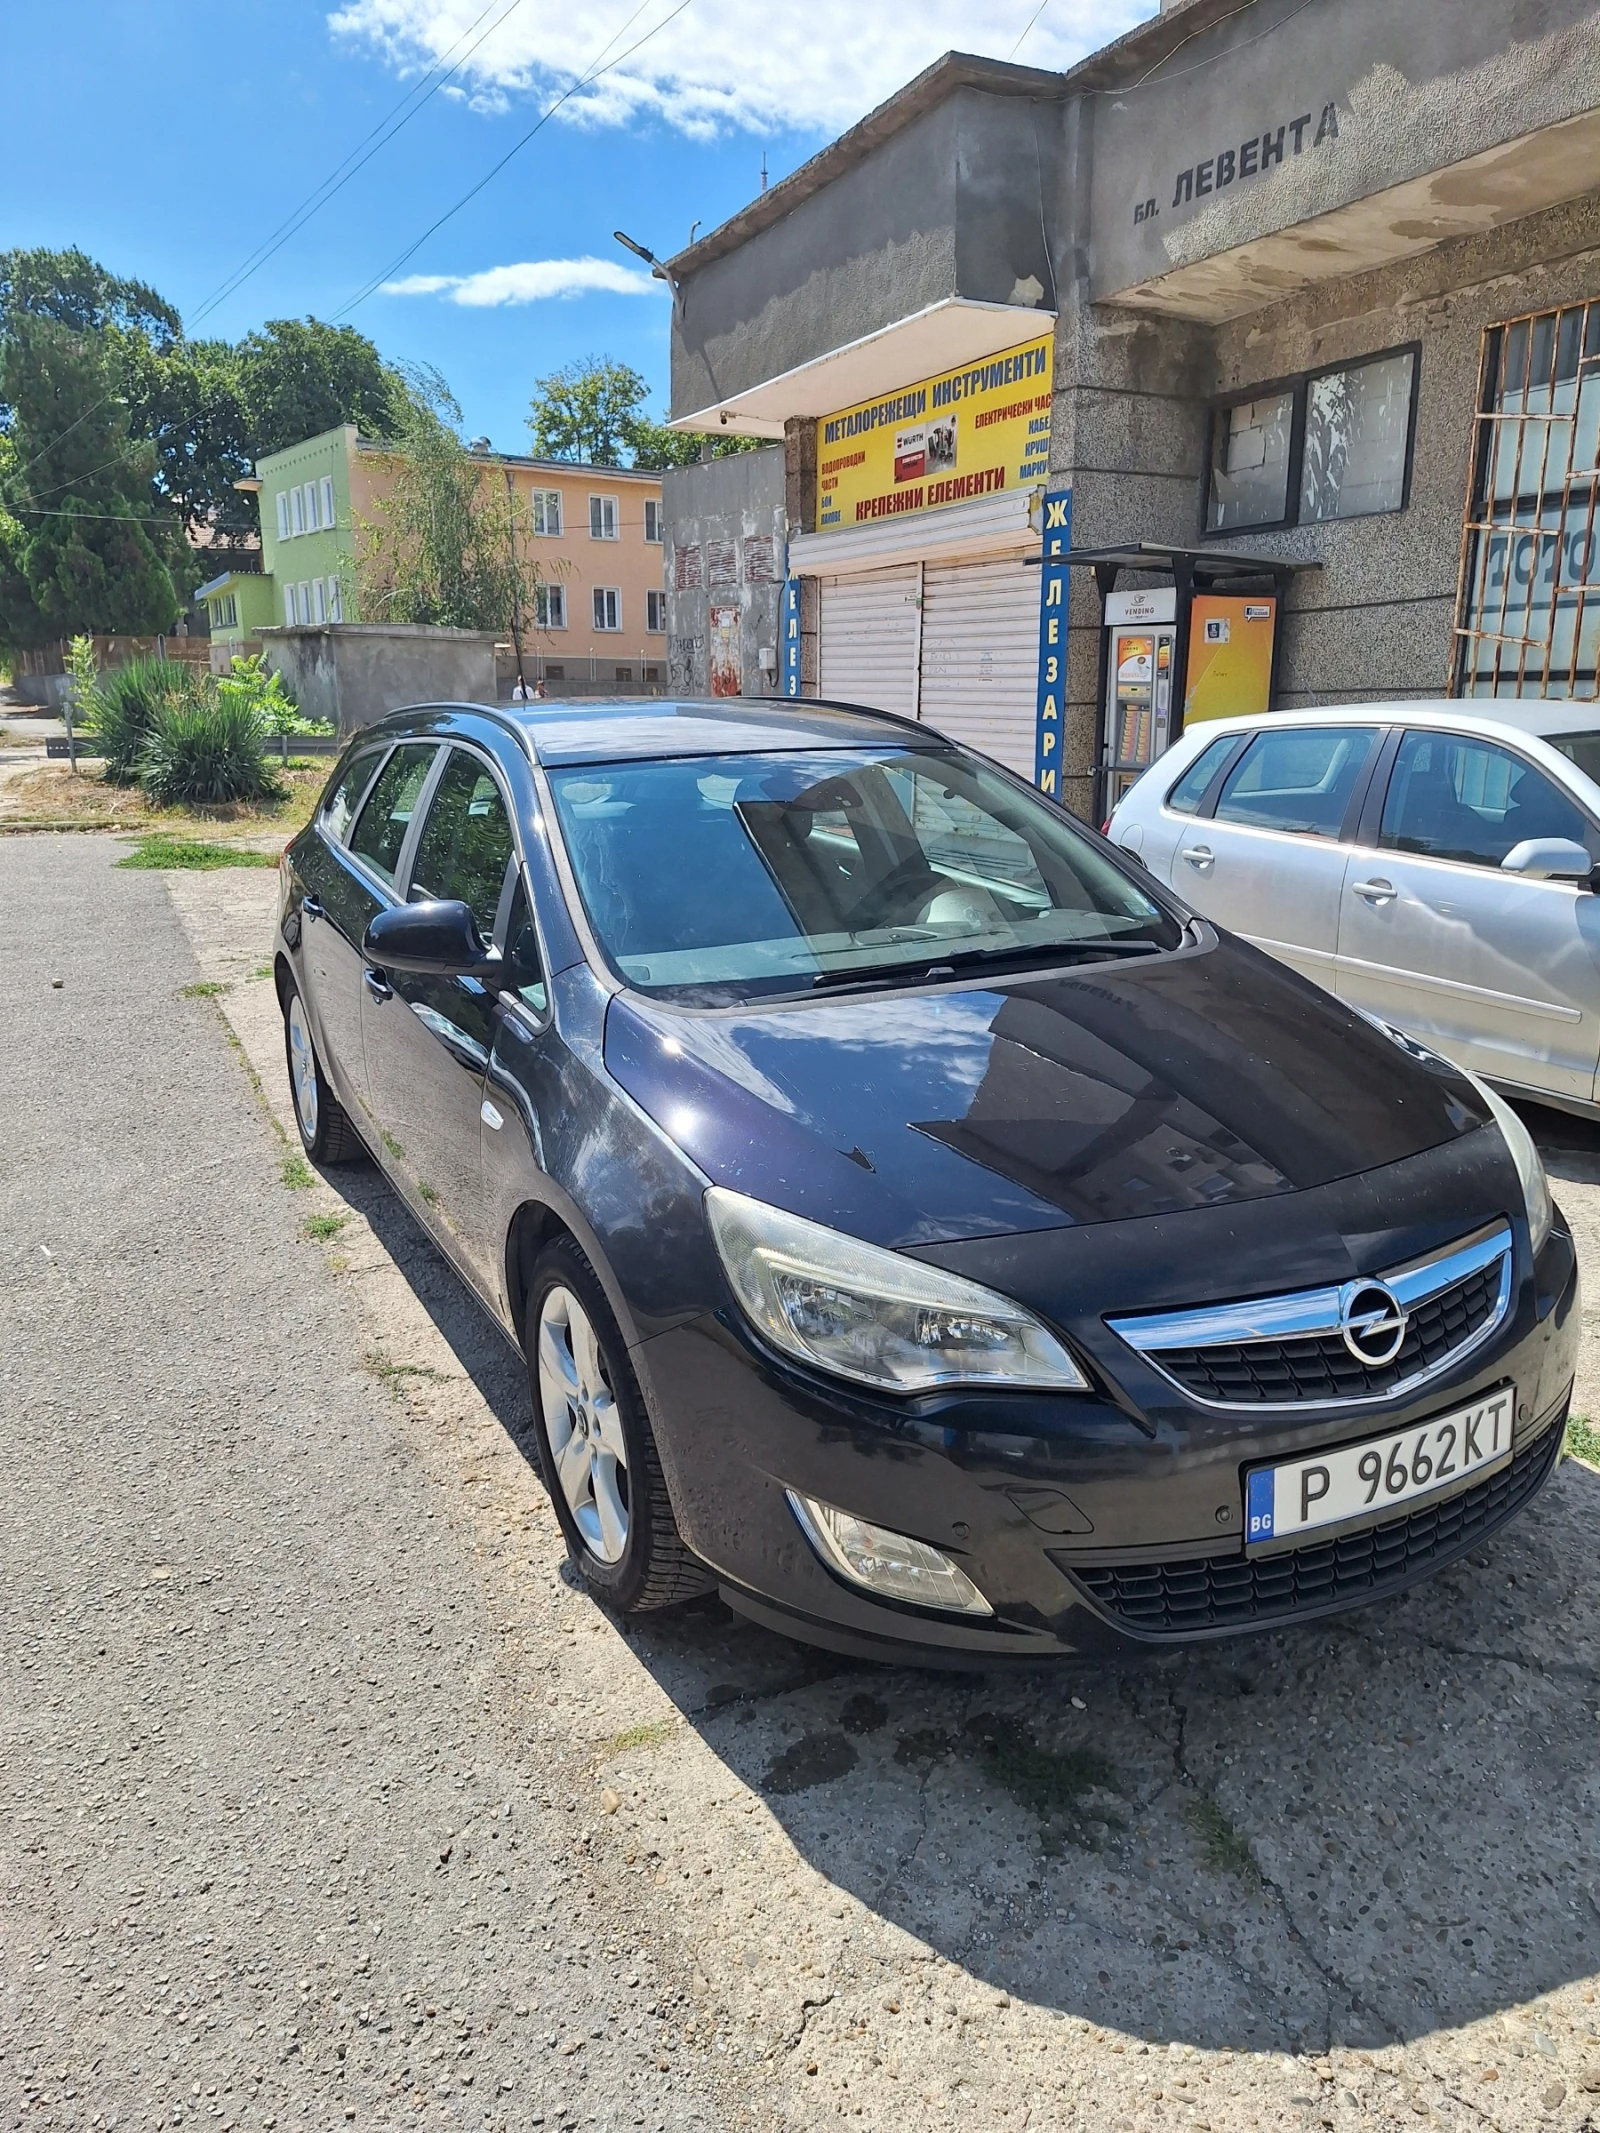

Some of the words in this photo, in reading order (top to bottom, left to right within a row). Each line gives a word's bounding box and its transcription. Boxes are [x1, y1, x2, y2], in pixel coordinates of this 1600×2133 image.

[1172, 102, 1339, 208] ЛЕВЕНТА
[824, 388, 927, 445] МЕТАЛОРЕЖЕЩИ
[932, 346, 1046, 409] ИНСТРУМЕНТИ
[975, 398, 1034, 430] ЕЛЕКТРИЧЕСКИ
[1028, 416, 1051, 435] КАБЕ
[856, 486, 924, 521] КРЕПЕЖНИ
[927, 466, 1006, 507] ЕЛЕМЕНТИ
[1124, 606, 1155, 616] VENDING
[1040, 499, 1069, 794] ЖЕЛЕЗАРИ
[1301, 1466, 1330, 1522] P
[1358, 1399, 1507, 1504] 9662KT
[1251, 1513, 1272, 1533] BG
